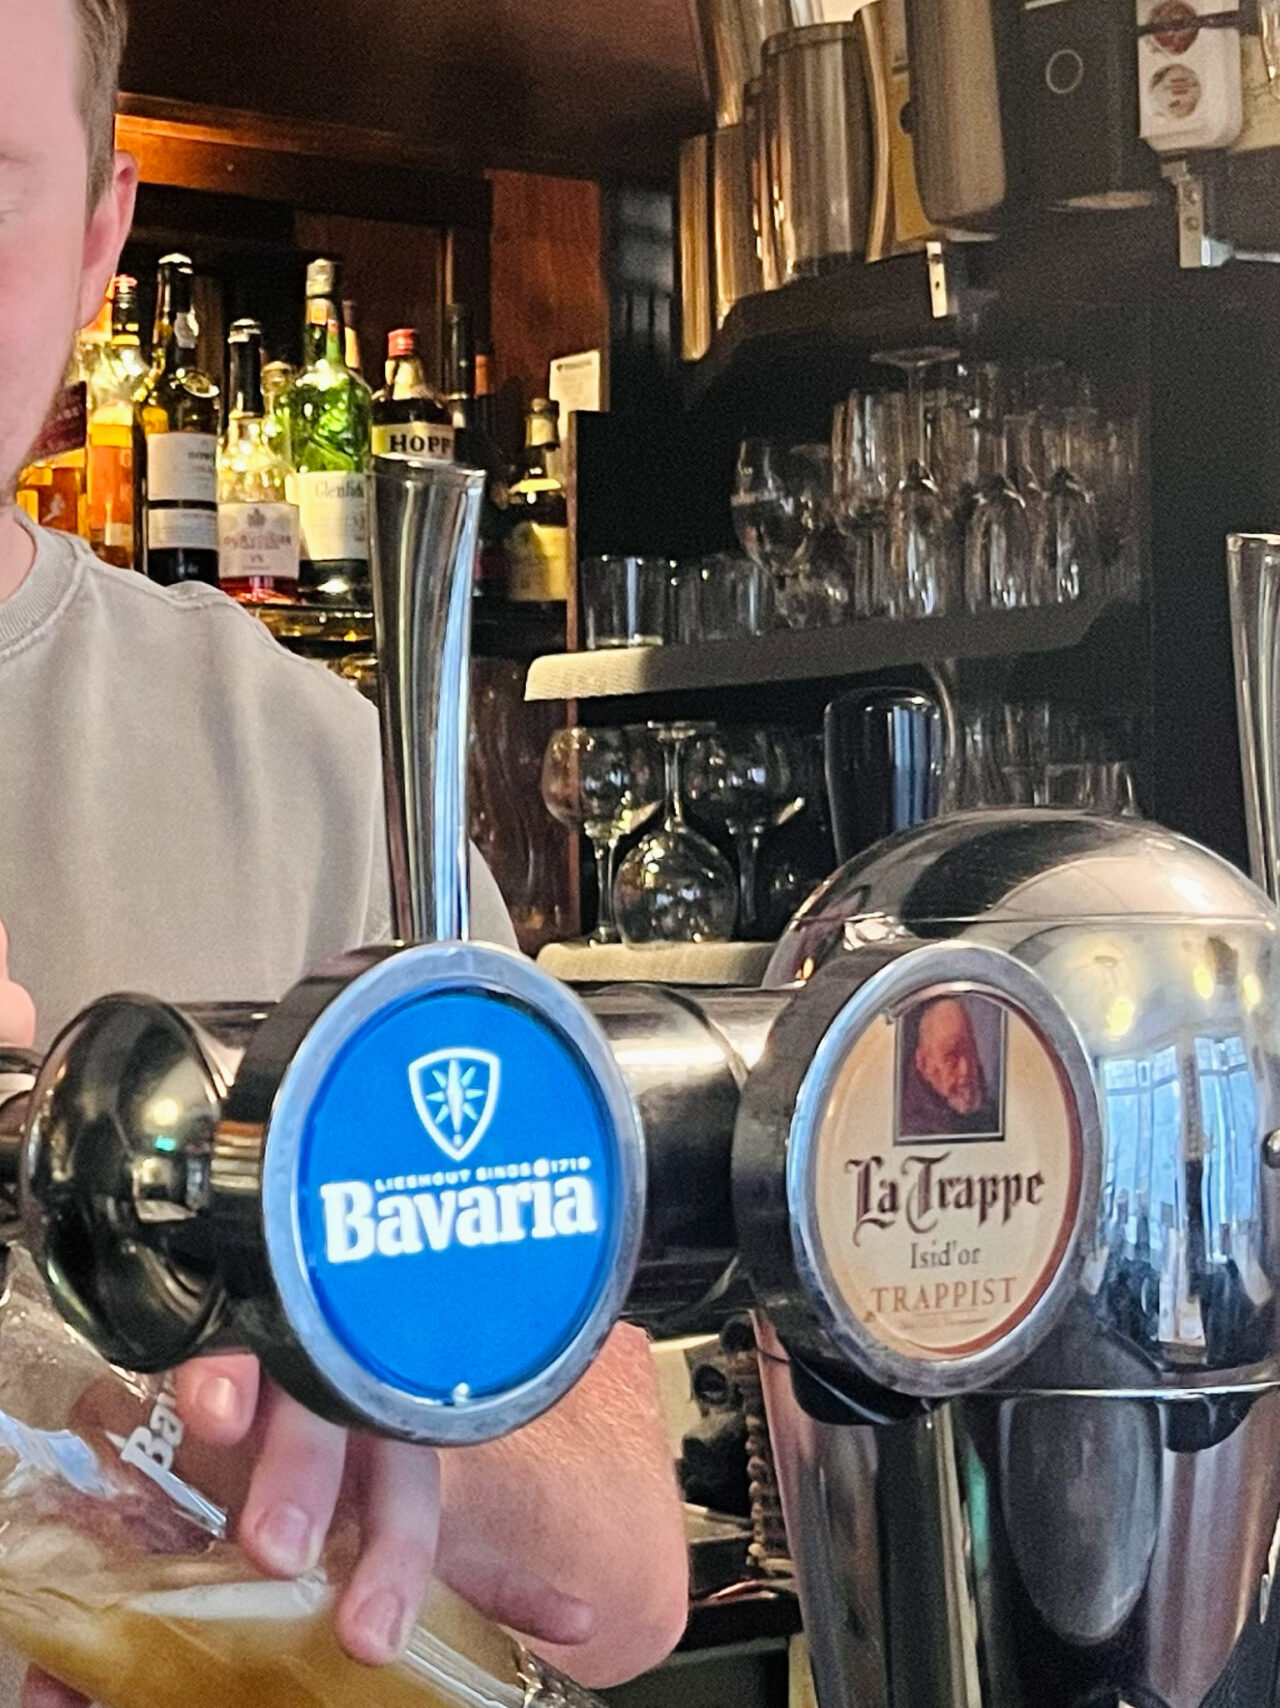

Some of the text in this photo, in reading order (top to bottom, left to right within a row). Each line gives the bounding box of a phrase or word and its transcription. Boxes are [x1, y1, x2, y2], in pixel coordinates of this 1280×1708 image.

[320, 1176, 598, 1265] Bavaria
[902, 1151, 1045, 1234] Trappe
[870, 1276, 1017, 1314] TRAPPIST
